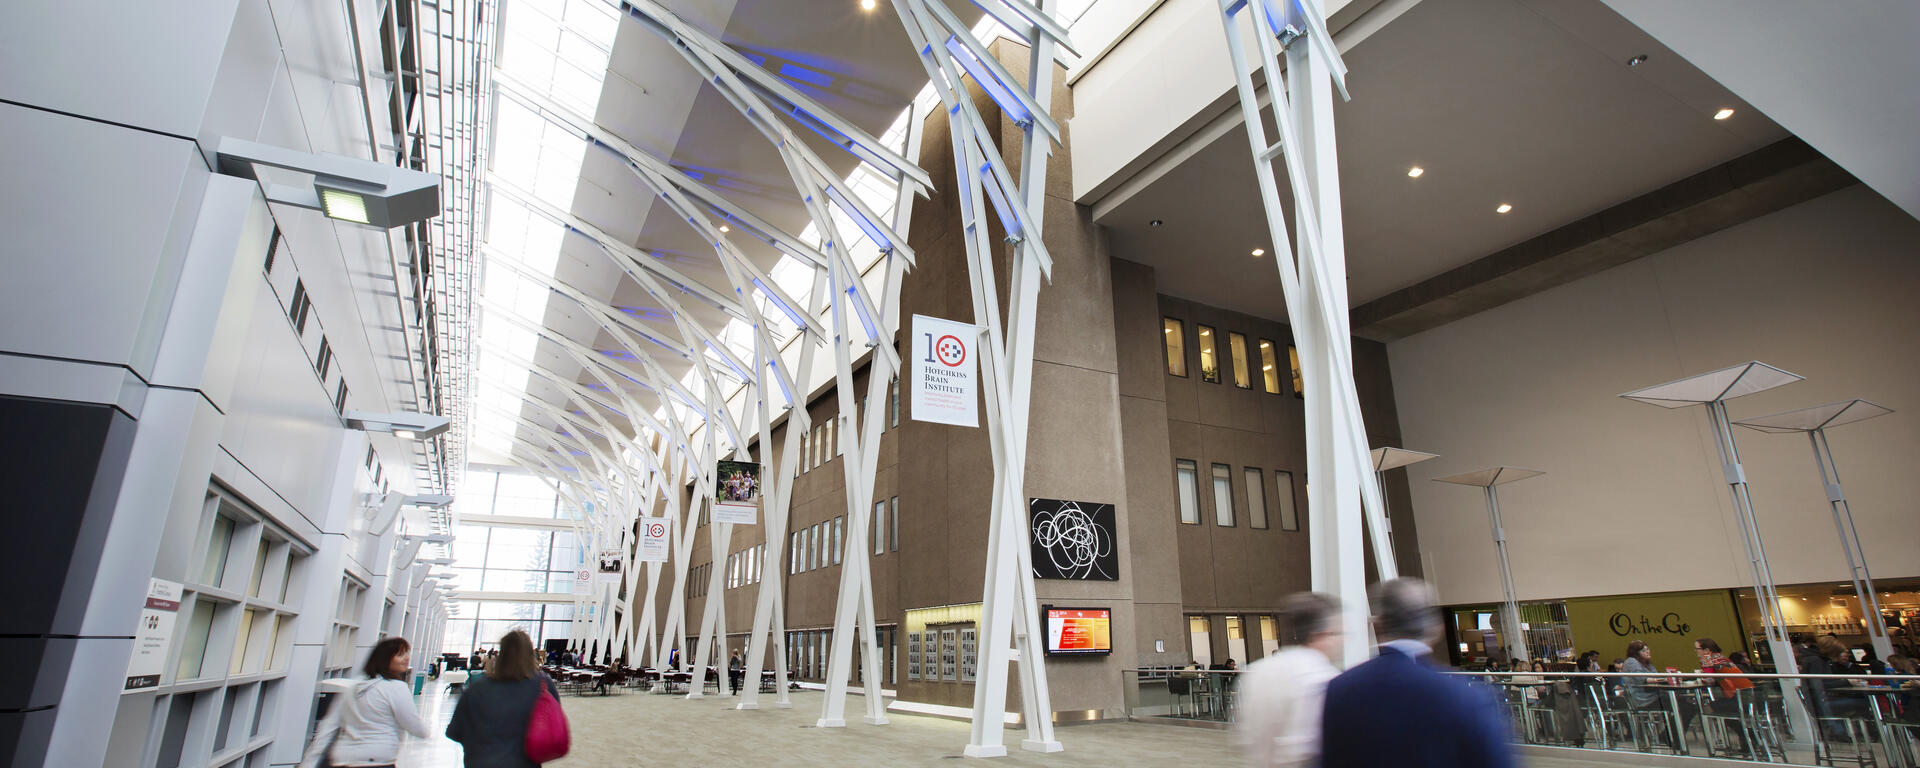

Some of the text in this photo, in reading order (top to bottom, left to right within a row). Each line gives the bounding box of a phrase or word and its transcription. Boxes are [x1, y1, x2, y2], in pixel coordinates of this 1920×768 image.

[924, 332, 966, 367] 10
[924, 366, 967, 379] HOTCHKISS
[924, 374, 949, 384] BRAIN
[924, 382, 964, 394] INSTITUTE
[1609, 612, 1691, 636] On the Go
